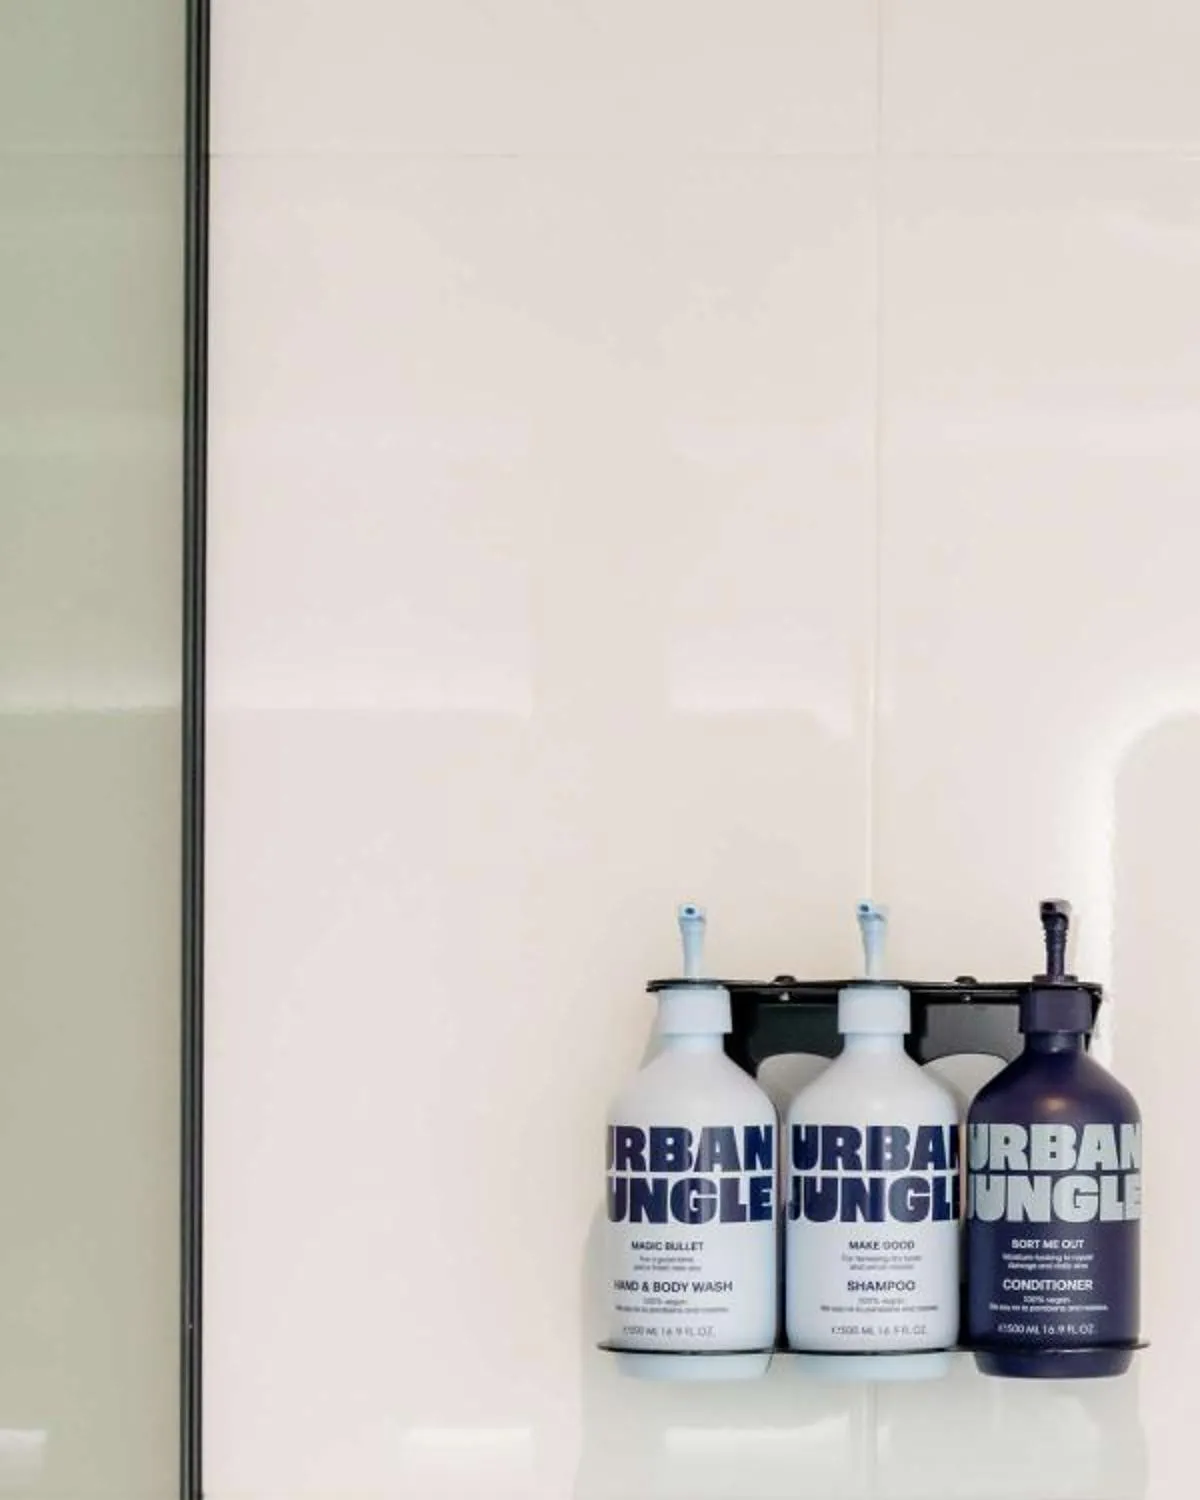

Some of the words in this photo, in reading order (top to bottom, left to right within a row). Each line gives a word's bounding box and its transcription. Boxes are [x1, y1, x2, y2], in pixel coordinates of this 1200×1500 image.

[969, 1123, 1141, 1171] URBAN
[607, 1176, 773, 1224] UNGLE
[665, 1241, 704, 1251] BULLET
[849, 1241, 880, 1250] MAKE
[1043, 1240, 1060, 1249] ME
[1061, 1239, 1085, 1249] OUT
[614, 1281, 639, 1291] HAND
[642, 1282, 649, 1292] &
[653, 1282, 688, 1292] BODY
[692, 1281, 733, 1292] WASH
[847, 1281, 916, 1291] SHAMPOO
[1002, 1279, 1094, 1291] CONDITIONER
